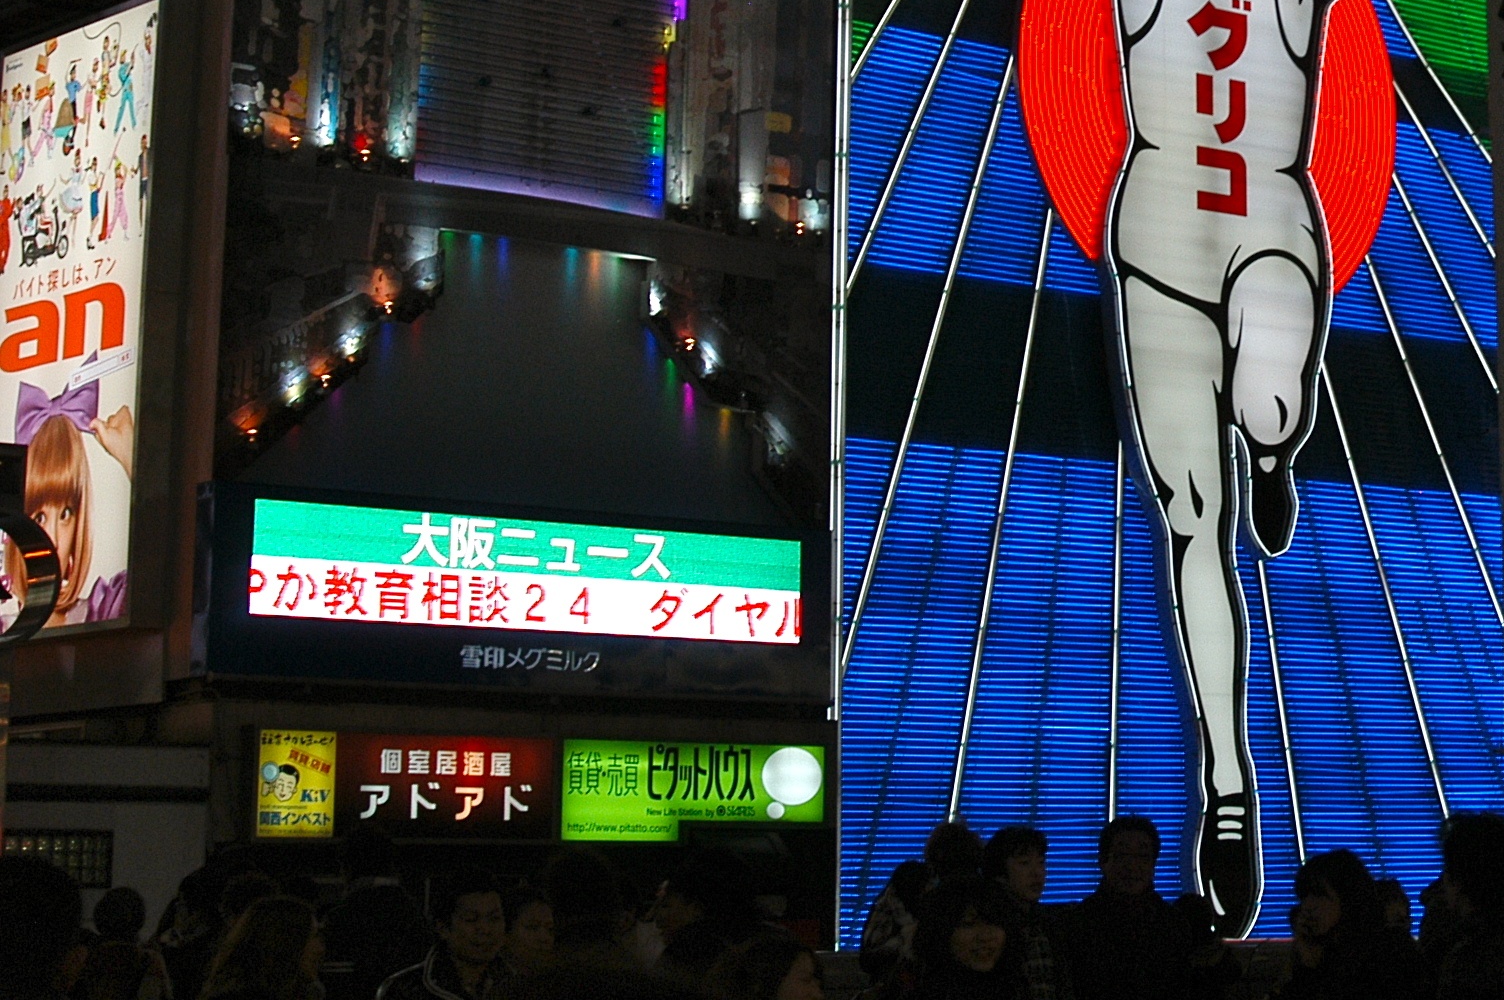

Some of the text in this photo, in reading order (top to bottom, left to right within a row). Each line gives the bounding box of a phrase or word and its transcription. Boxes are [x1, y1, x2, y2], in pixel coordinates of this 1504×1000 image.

[13, 256, 118, 300] バイト探しは、アン
[0, 281, 126, 374] an
[402, 512, 672, 581] 大阪ニュース
[459, 645, 601, 673] 雪印メグミルク
[380, 748, 512, 778] 個室居酒屋
[567, 743, 756, 801] 賃貸・売買 ピタットハウス
[359, 781, 534, 822] アドアド
